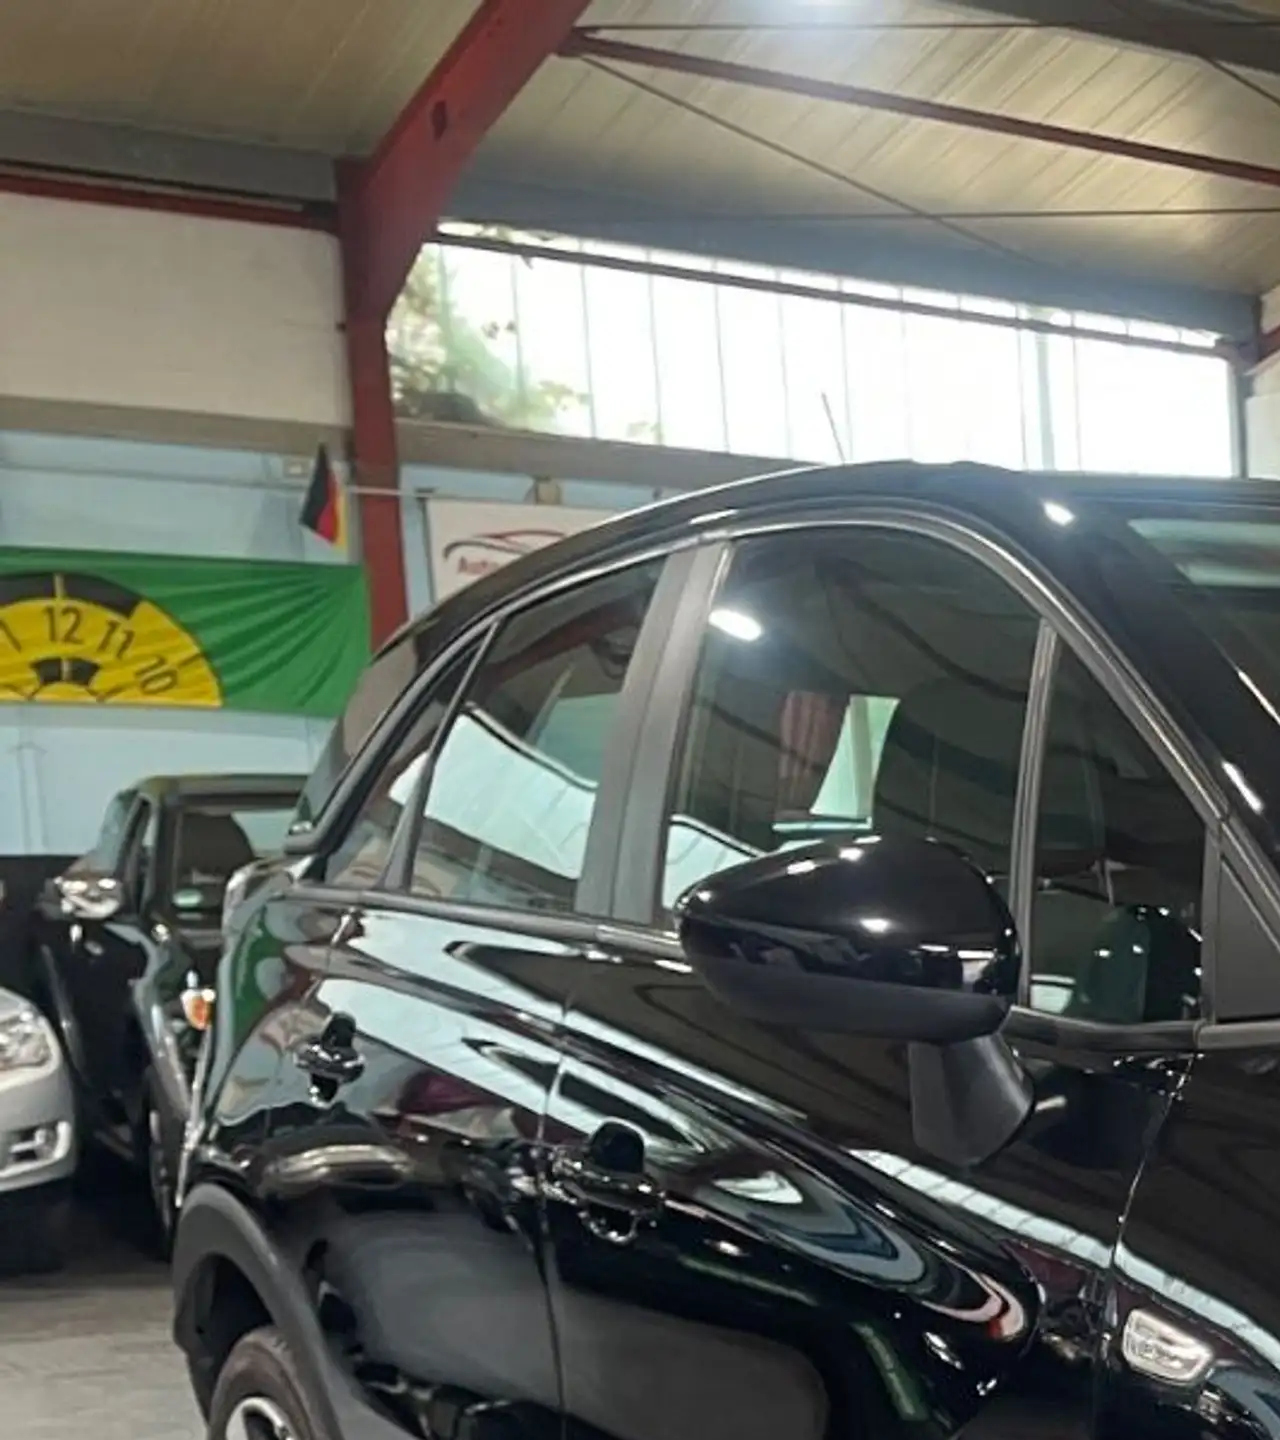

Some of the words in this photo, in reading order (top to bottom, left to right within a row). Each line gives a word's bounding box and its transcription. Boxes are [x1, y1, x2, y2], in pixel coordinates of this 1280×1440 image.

[43, 606, 83, 645] 12
[97, 619, 135, 660] 11
[134, 655, 178, 695] 10
